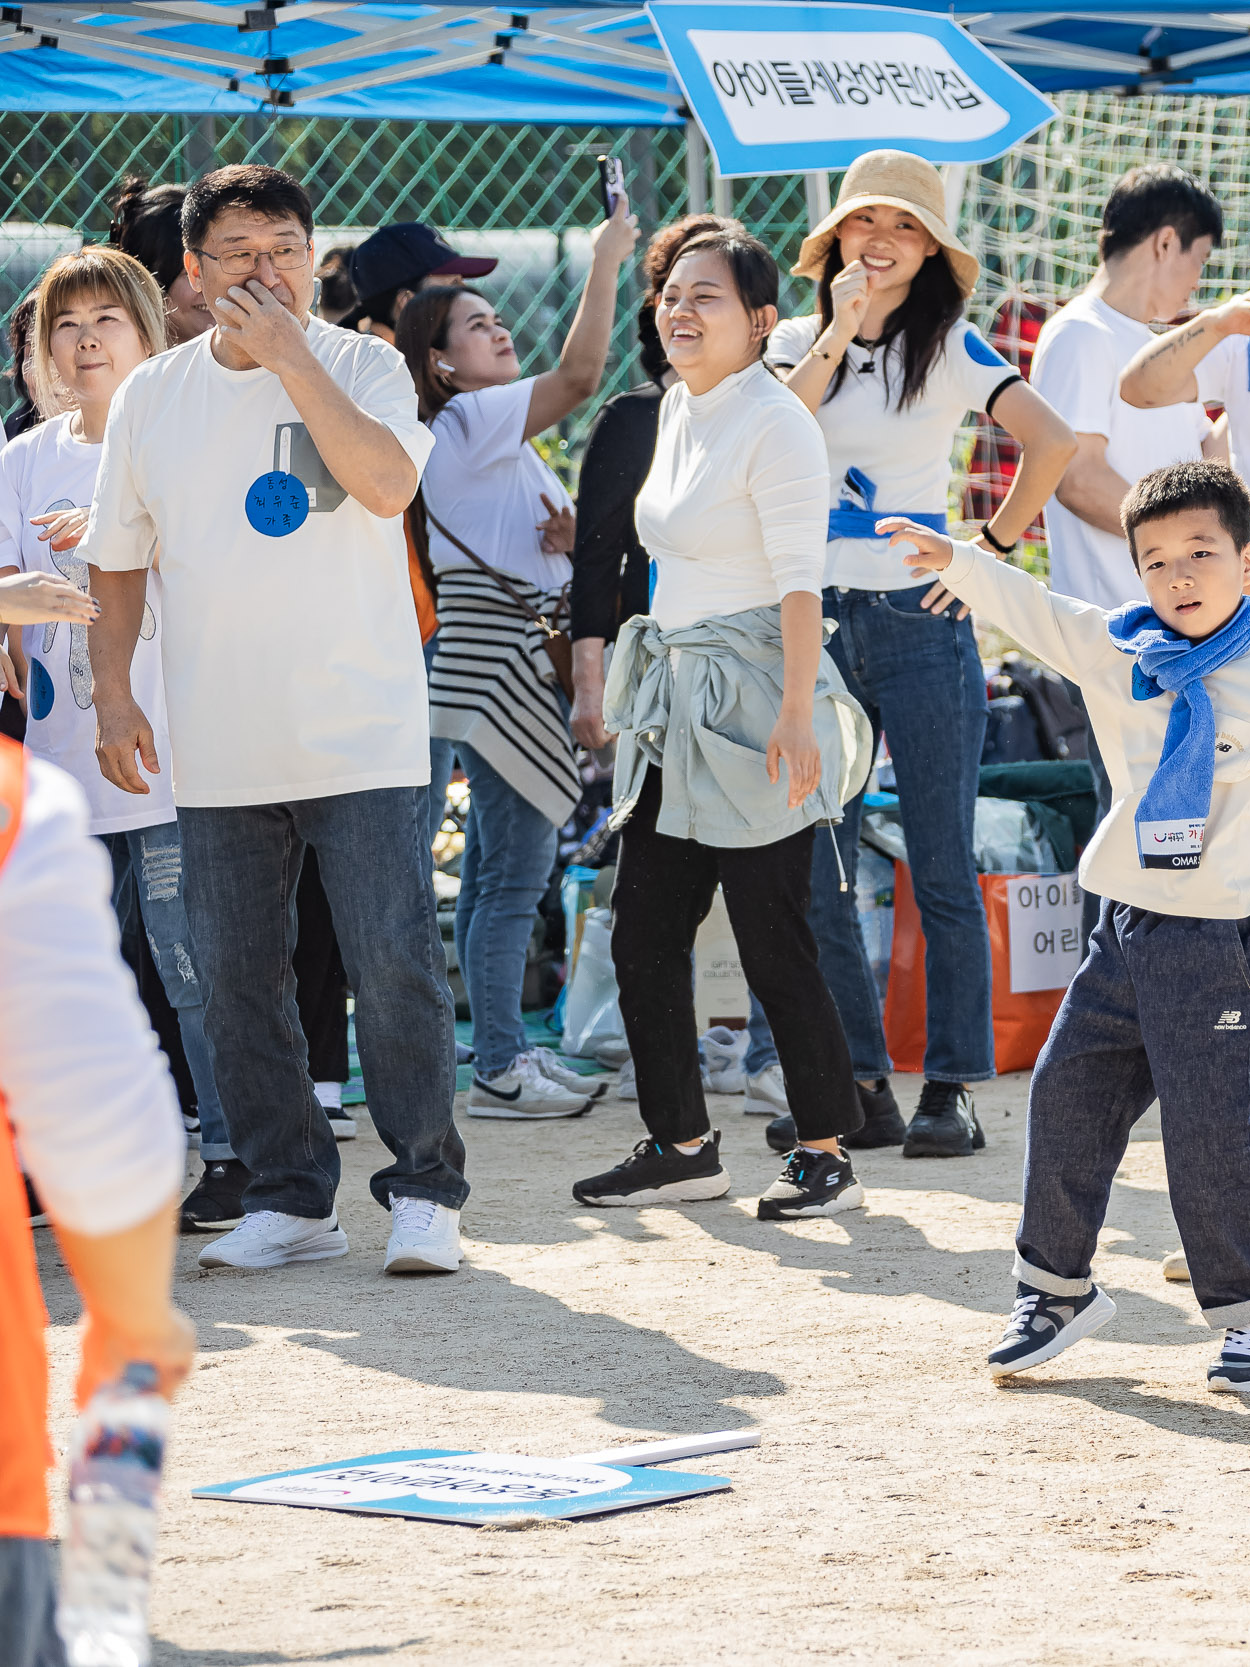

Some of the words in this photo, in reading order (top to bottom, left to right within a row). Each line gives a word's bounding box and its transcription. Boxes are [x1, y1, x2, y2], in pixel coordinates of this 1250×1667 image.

[712, 60, 984, 110] 아이들세상어린이집
[267, 476, 288, 490] 동성
[264, 513, 292, 528] 가족
[1172, 855, 1198, 867] OMAR
[313, 1468, 581, 1500] 동성어린이집
